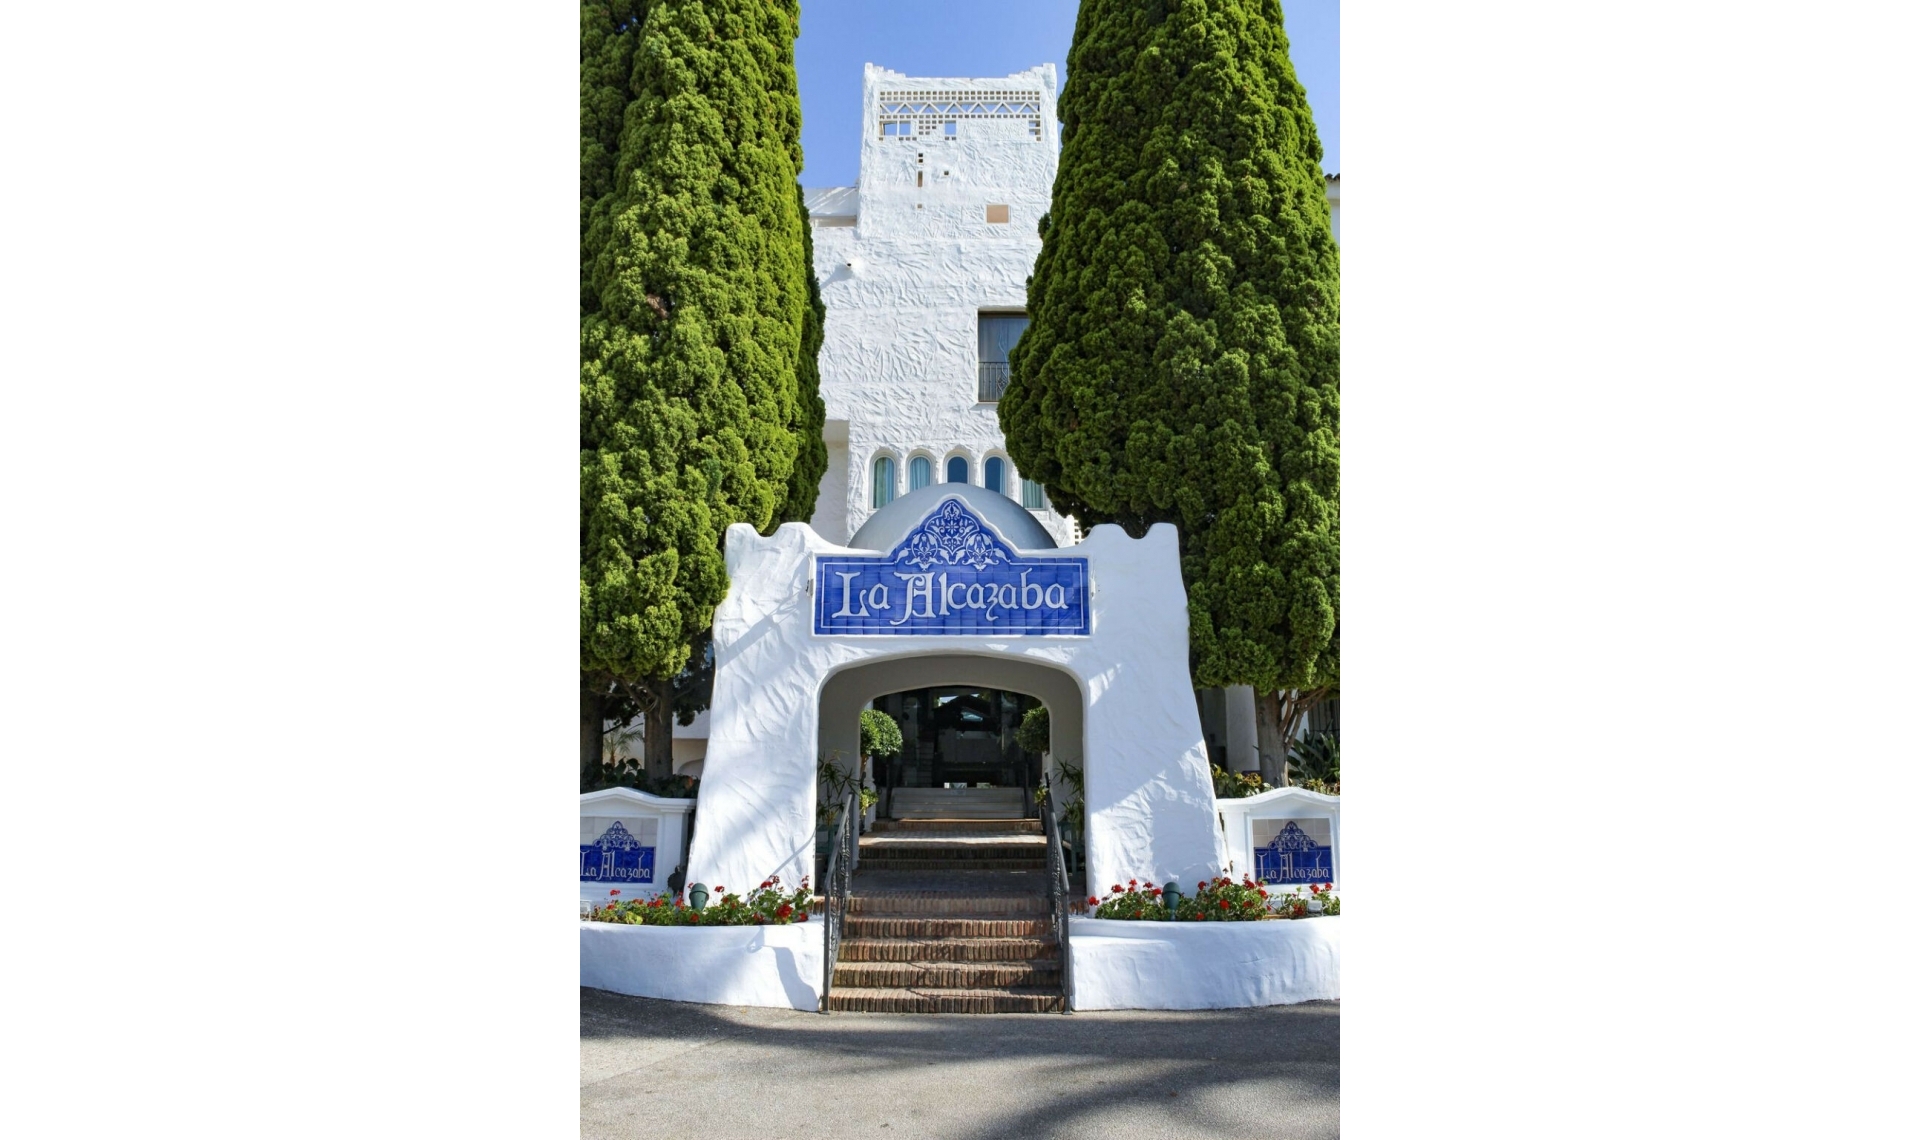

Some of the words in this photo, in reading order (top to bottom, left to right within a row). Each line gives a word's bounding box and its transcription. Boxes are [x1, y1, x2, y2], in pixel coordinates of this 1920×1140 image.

[831, 571, 892, 619] La
[889, 567, 1070, 626] Alcazaba
[580, 849, 597, 877] La
[595, 848, 651, 882] Alcazaba
[1256, 852, 1278, 880] La
[1276, 850, 1330, 883] Alcazaba
